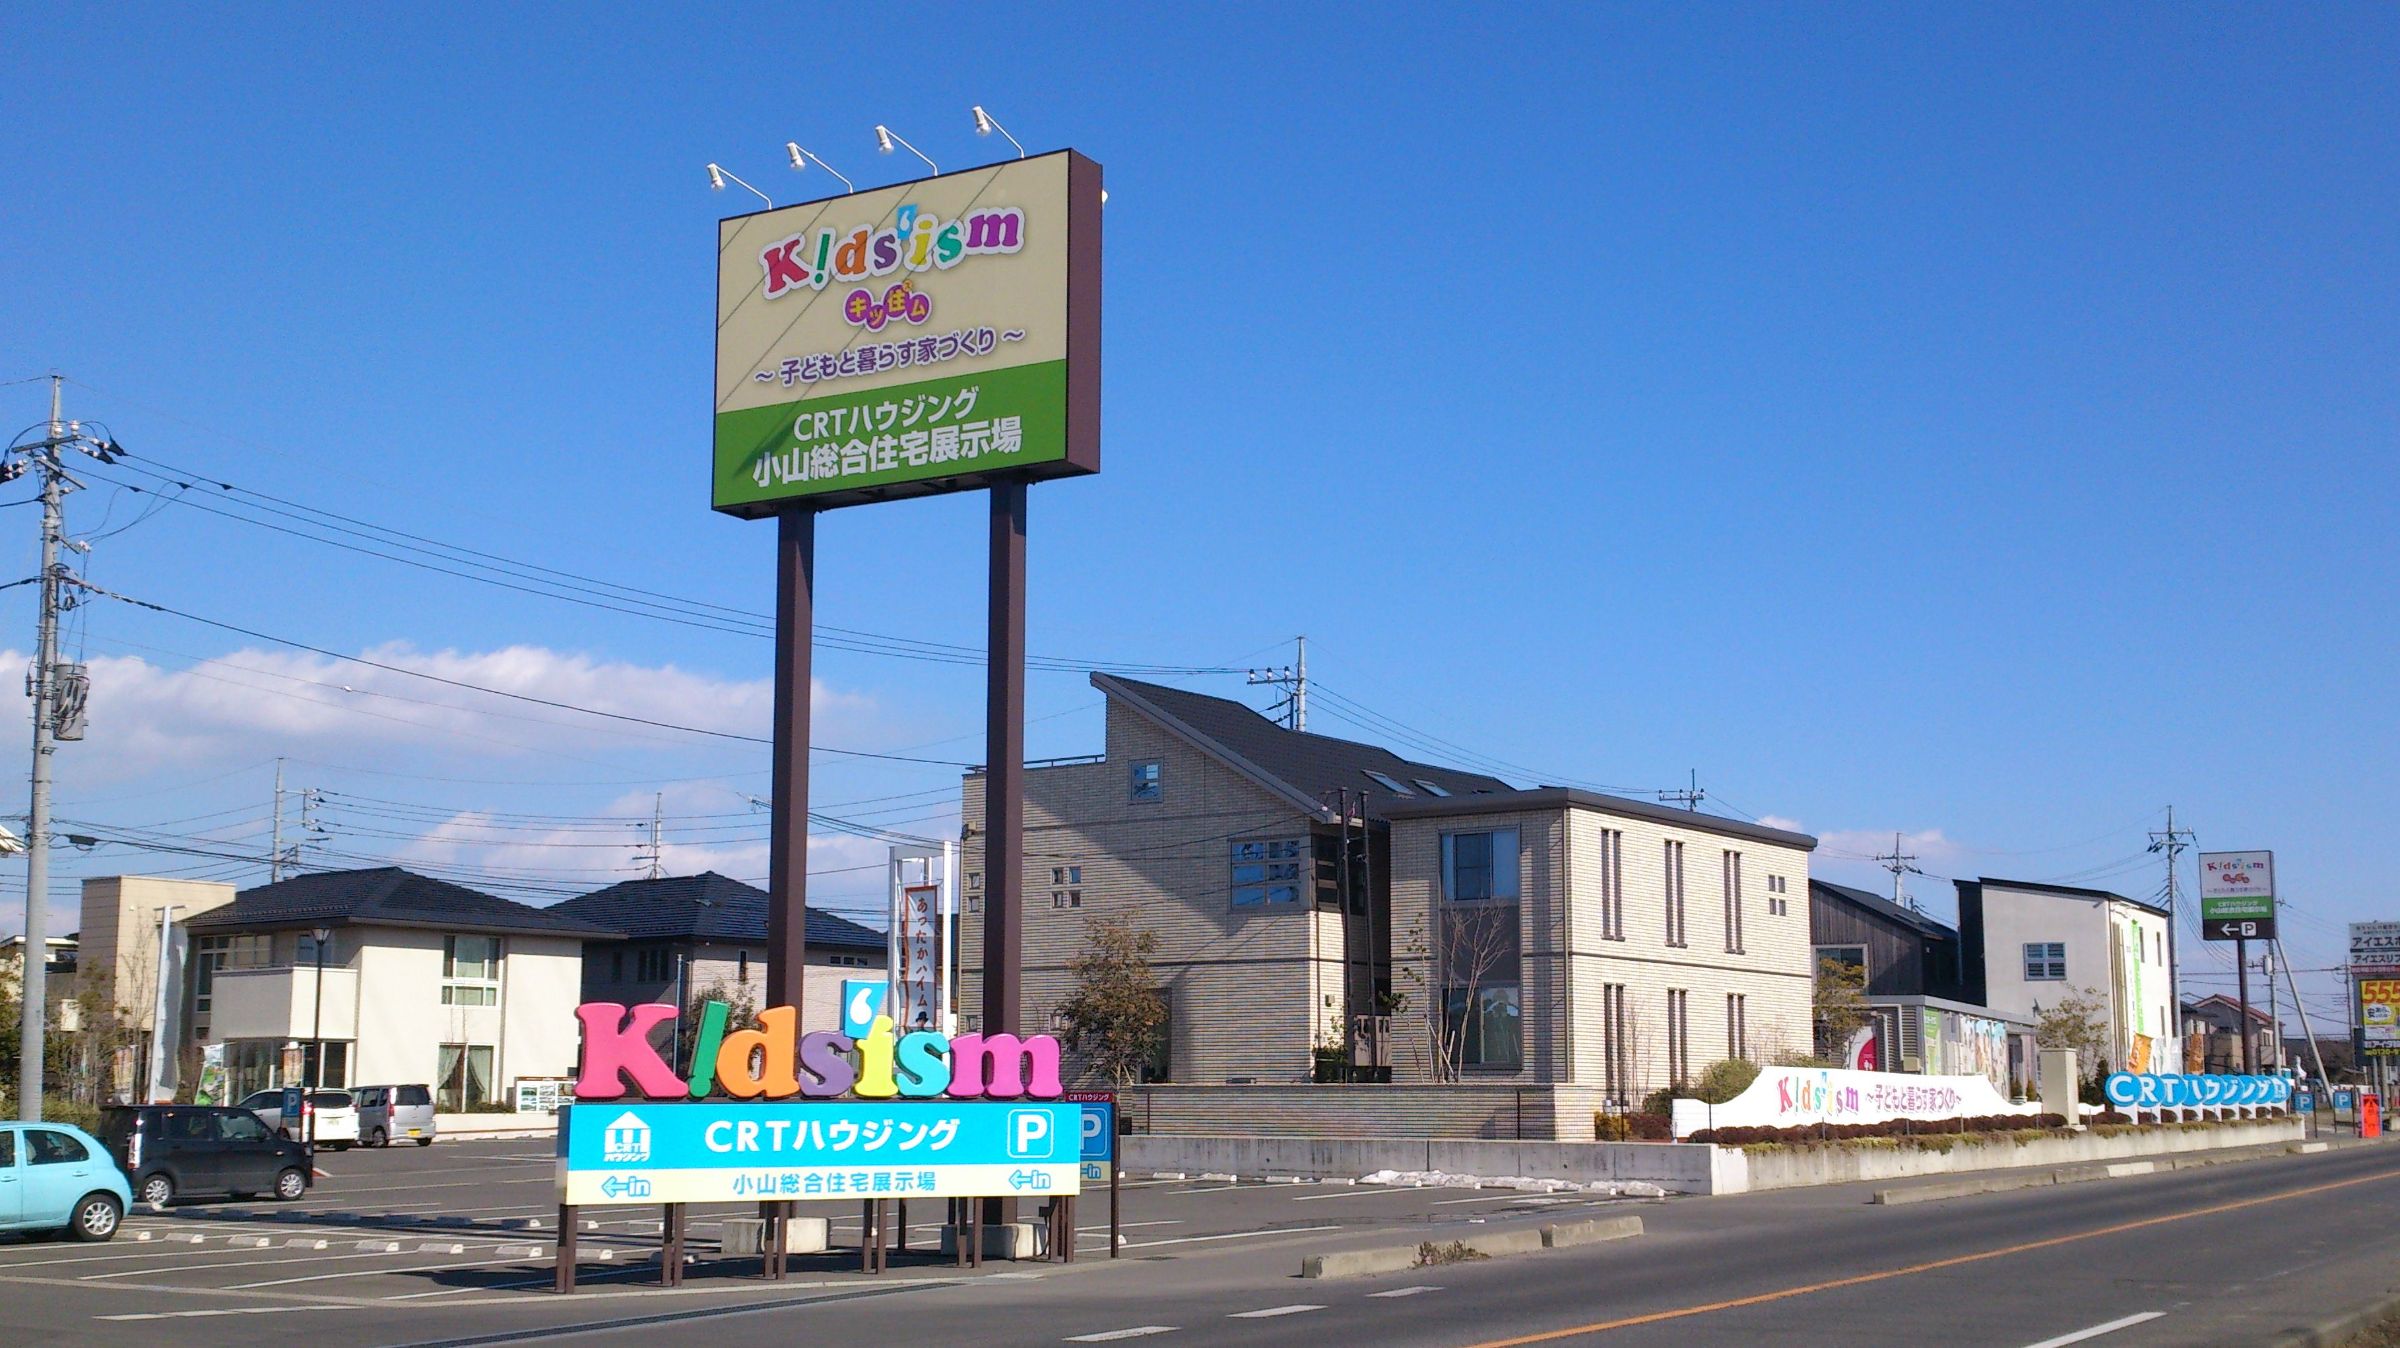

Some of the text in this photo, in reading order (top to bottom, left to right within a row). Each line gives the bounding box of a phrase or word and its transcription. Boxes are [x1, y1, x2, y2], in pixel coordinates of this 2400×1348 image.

[793, 386, 980, 442] CRTハウジング
[753, 416, 1023, 487] 小山総合住宅展示場
[2245, 923, 2254, 934] P
[915, 897, 929, 1008] あったかハイム
[287, 1093, 297, 1112] P
[1068, 1093, 1110, 1101] CRTハウジング
[2302, 1096, 2310, 1108] P
[2340, 1095, 2349, 1106] P
[704, 1118, 960, 1152] CRTハウジング
[1017, 1114, 1048, 1152] P
[1081, 1113, 1102, 1150] P
[1030, 1169, 1051, 1190] in
[1087, 1163, 1102, 1179] in
[628, 1175, 651, 1197] in
[733, 1171, 937, 1195] 小山総合住宅展示場
